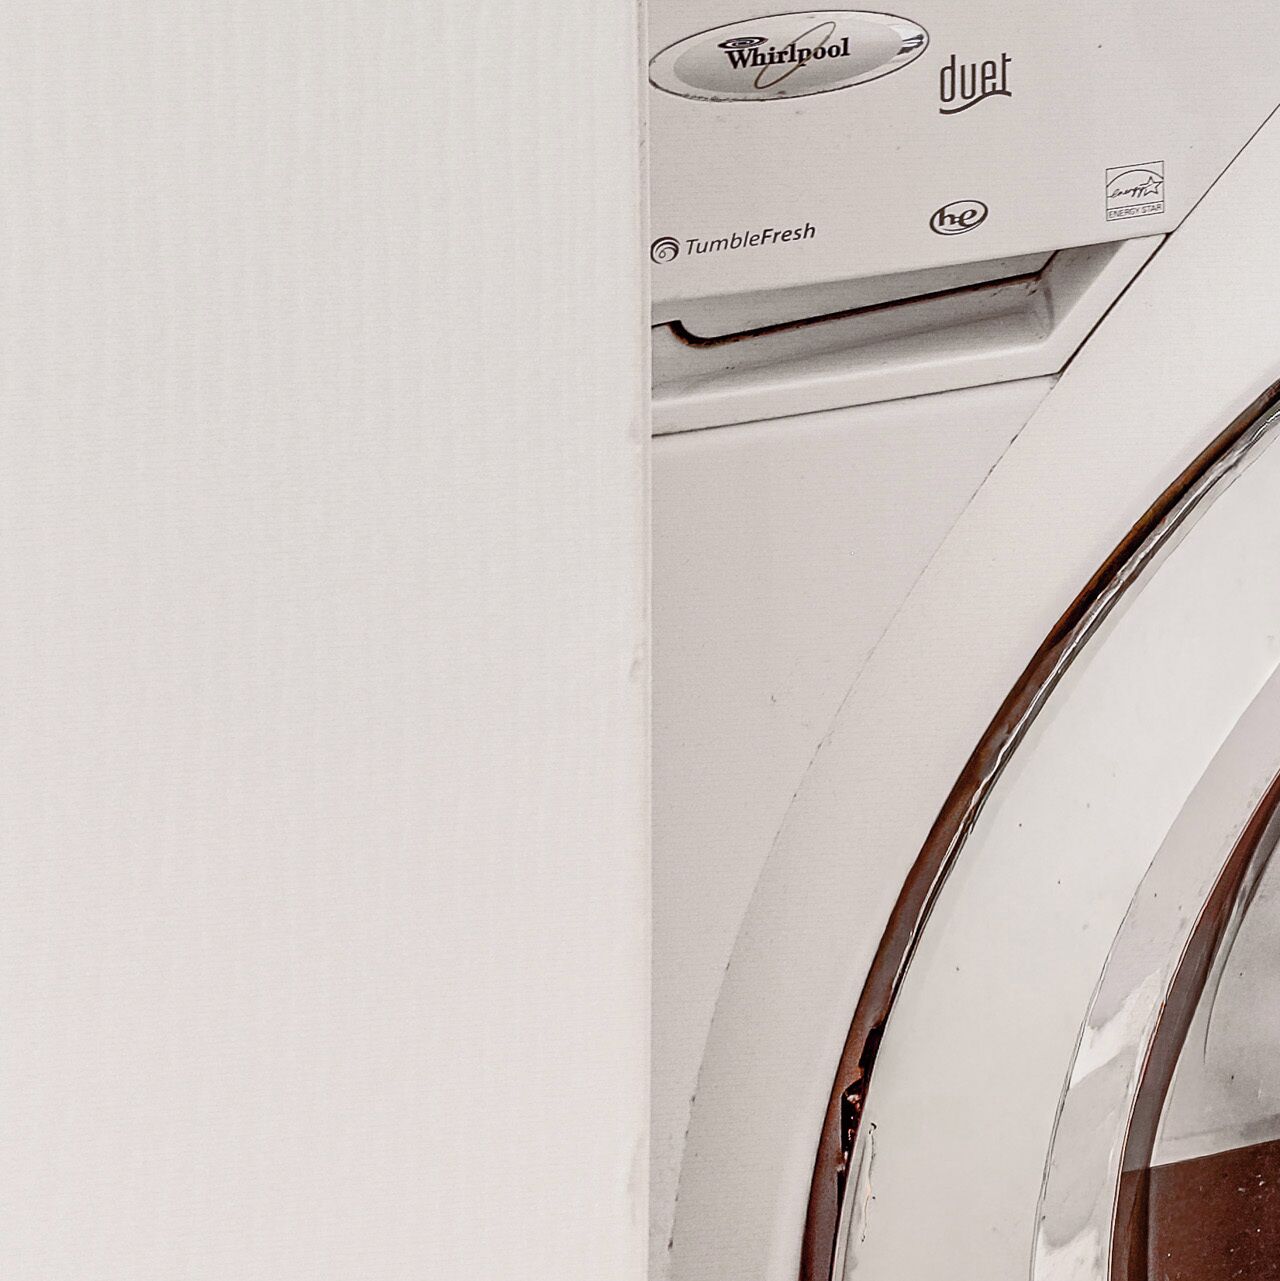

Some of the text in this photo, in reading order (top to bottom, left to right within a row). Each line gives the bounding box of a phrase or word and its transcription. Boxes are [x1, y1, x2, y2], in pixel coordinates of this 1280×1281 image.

[724, 37, 851, 70] Whirlpool
[940, 52, 1012, 104] duet
[938, 207, 978, 228] he
[1108, 203, 1162, 220] ENERGY STAR
[686, 222, 816, 256] TumbleFresh
